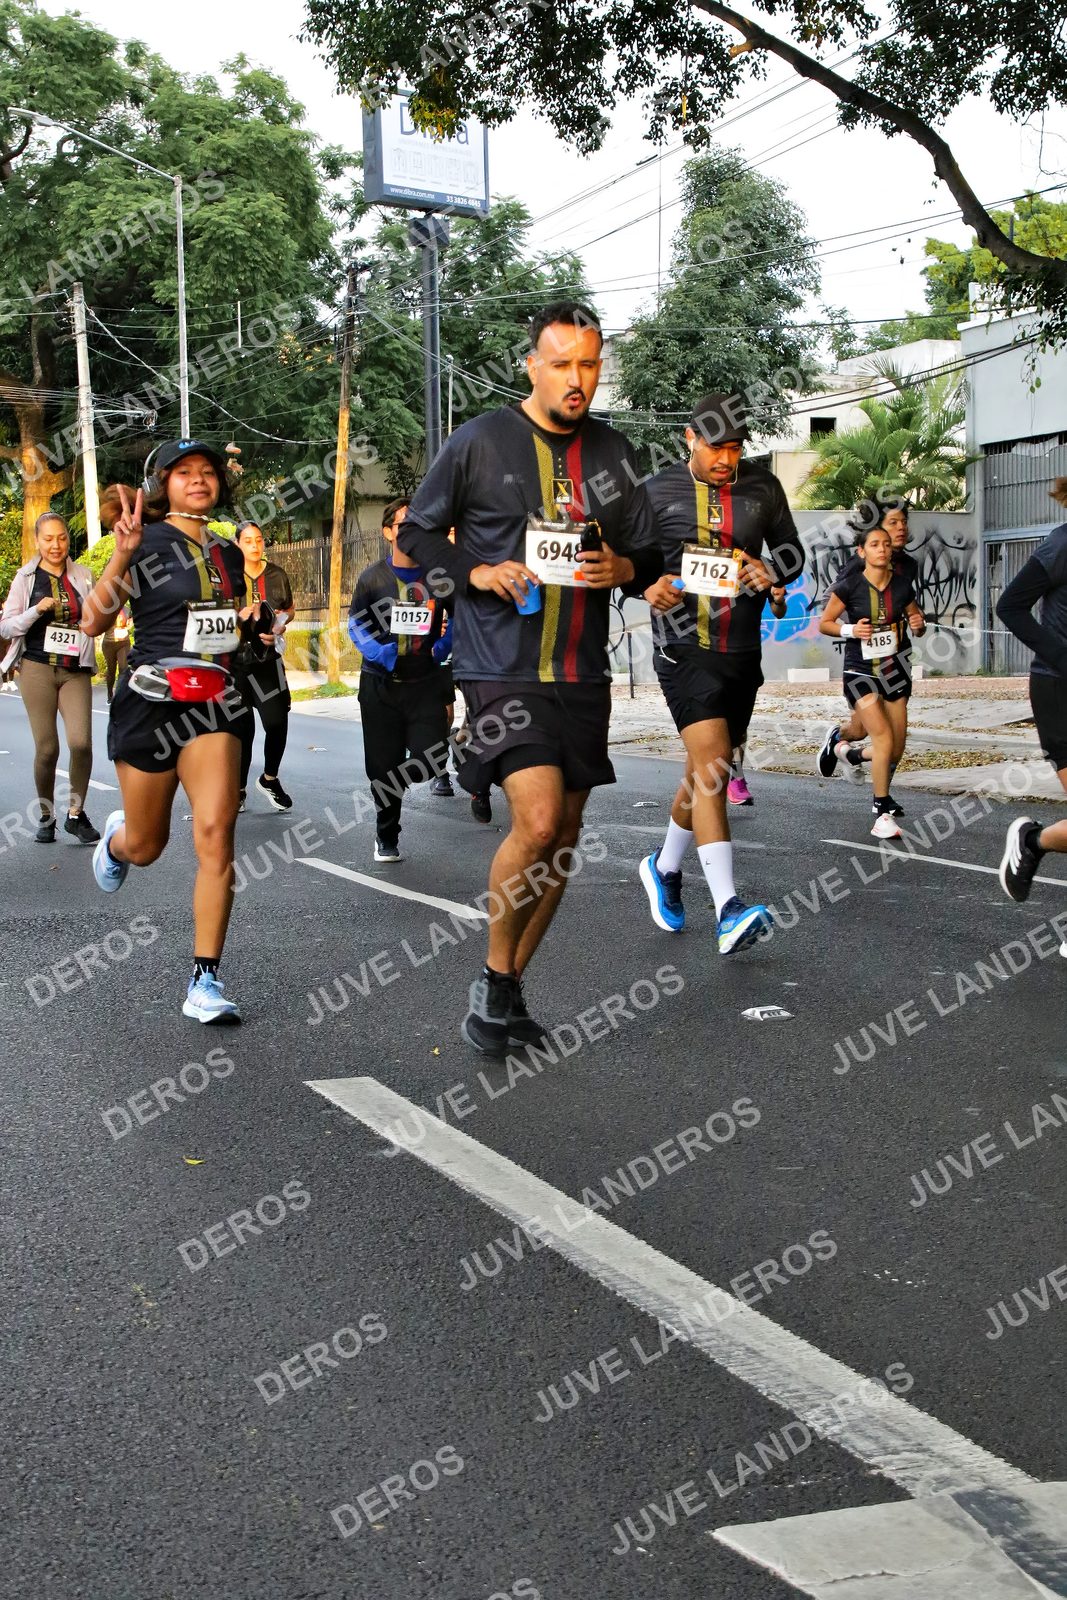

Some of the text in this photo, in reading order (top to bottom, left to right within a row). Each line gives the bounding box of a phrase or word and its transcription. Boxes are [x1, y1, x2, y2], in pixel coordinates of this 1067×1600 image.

[690, 561, 730, 580] 7162
[395, 611, 429, 623] 10157
[195, 616, 236, 636] 7304
[50, 630, 76, 645] 4321
[866, 634, 892, 648] 4185
